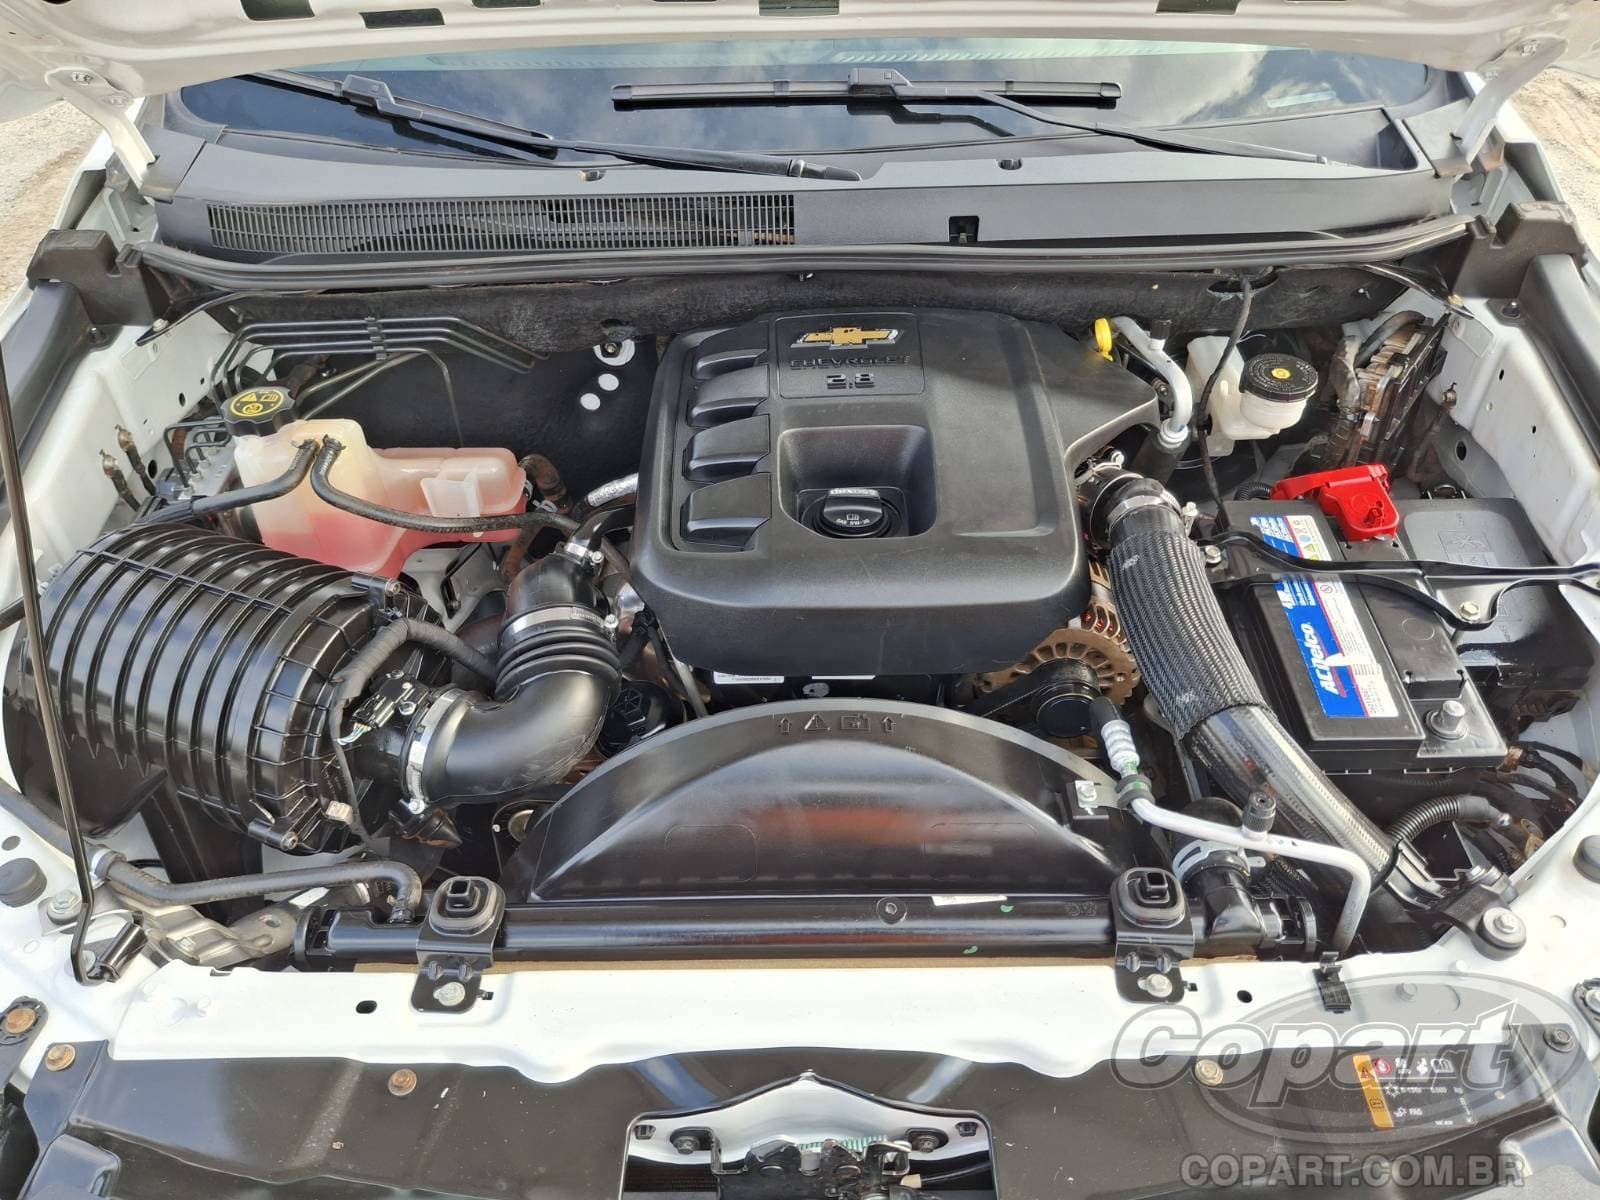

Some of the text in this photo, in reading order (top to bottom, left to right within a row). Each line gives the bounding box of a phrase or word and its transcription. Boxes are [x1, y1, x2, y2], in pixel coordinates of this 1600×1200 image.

[790, 355, 911, 369] CHEVROLET
[826, 373, 875, 389] 2.8
[1301, 622, 1340, 695] ACDelco
